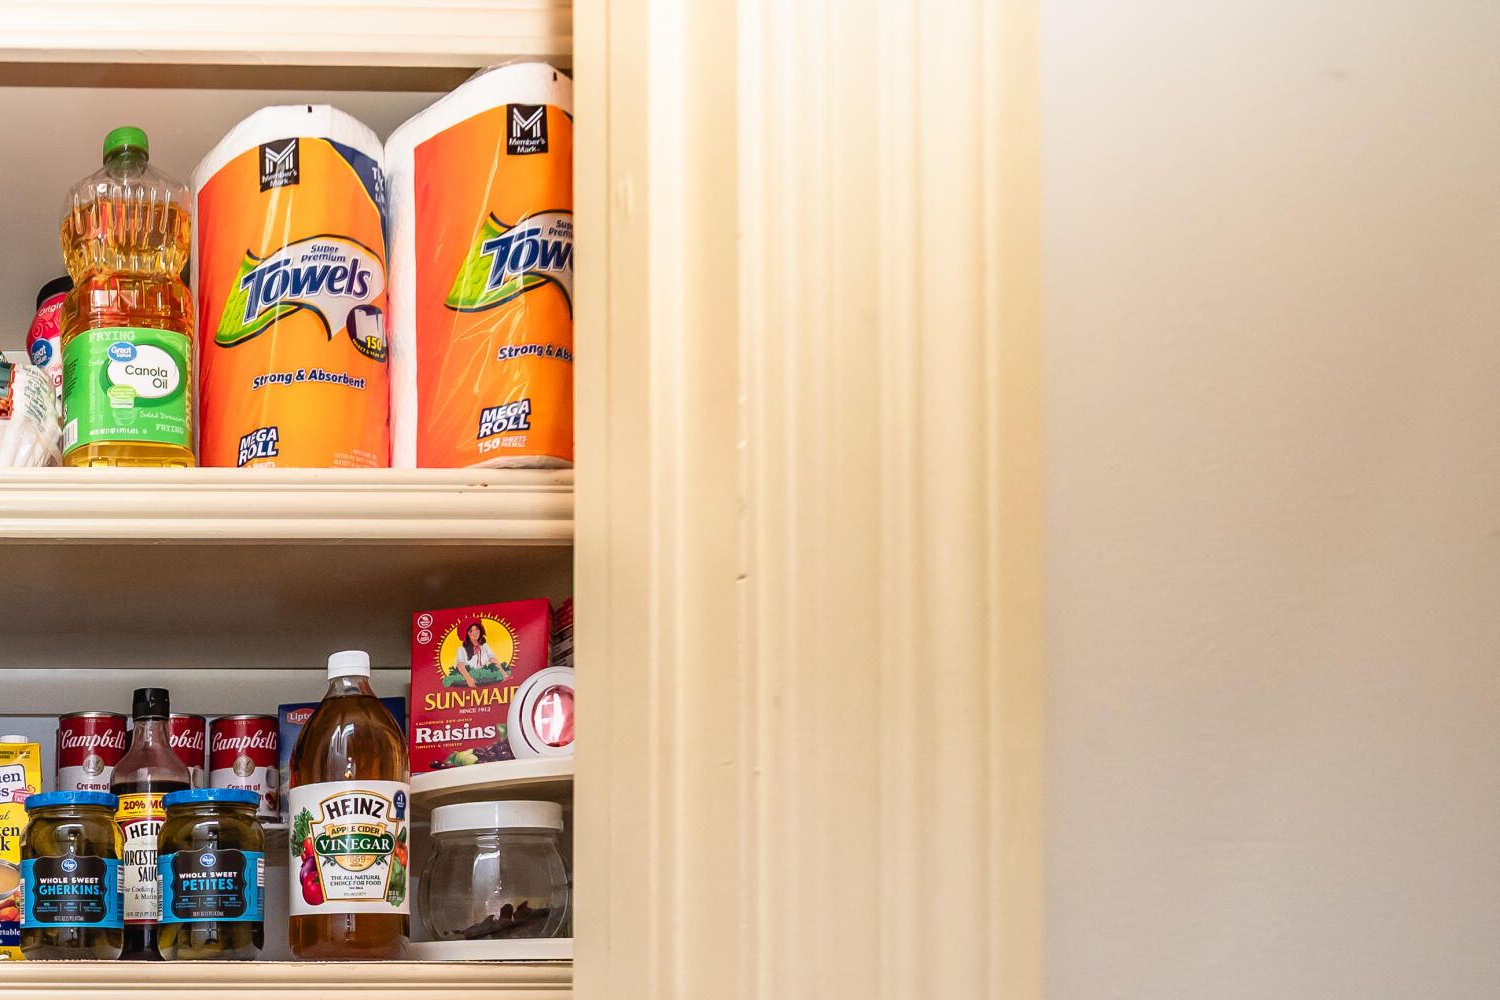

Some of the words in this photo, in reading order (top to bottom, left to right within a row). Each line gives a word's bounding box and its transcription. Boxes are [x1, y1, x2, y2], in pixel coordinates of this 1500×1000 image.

[508, 137, 546, 146] Member's
[517, 145, 537, 153] Mark
[310, 244, 339, 254] Super
[301, 253, 346, 264] premium
[480, 225, 574, 292] Tow
[241, 258, 371, 325] Towels
[89, 330, 136, 343] FRYING
[498, 345, 544, 360] Strong
[546, 345, 553, 357] &
[125, 365, 168, 378] Canola
[153, 378, 168, 389] Oil
[253, 371, 293, 390] Strong
[296, 369, 306, 381] &
[308, 369, 365, 390] Absorbent
[482, 400, 530, 423] MEGA
[480, 413, 529, 437] ROLL
[240, 428, 278, 450] MEGA
[478, 437, 500, 454] 150
[238, 442, 277, 466] ROLL
[415, 723, 496, 744] Raisins
[77, 782, 99, 791] Cream
[101, 782, 110, 791] of
[123, 800, 146, 810] 20%
[326, 797, 385, 820] HEINZ
[331, 825, 356, 835] APPLE
[357, 825, 380, 835] CIDER
[320, 838, 390, 851] VINEGAR
[39, 884, 100, 896] GHERKINS
[182, 879, 234, 891] PETITES
